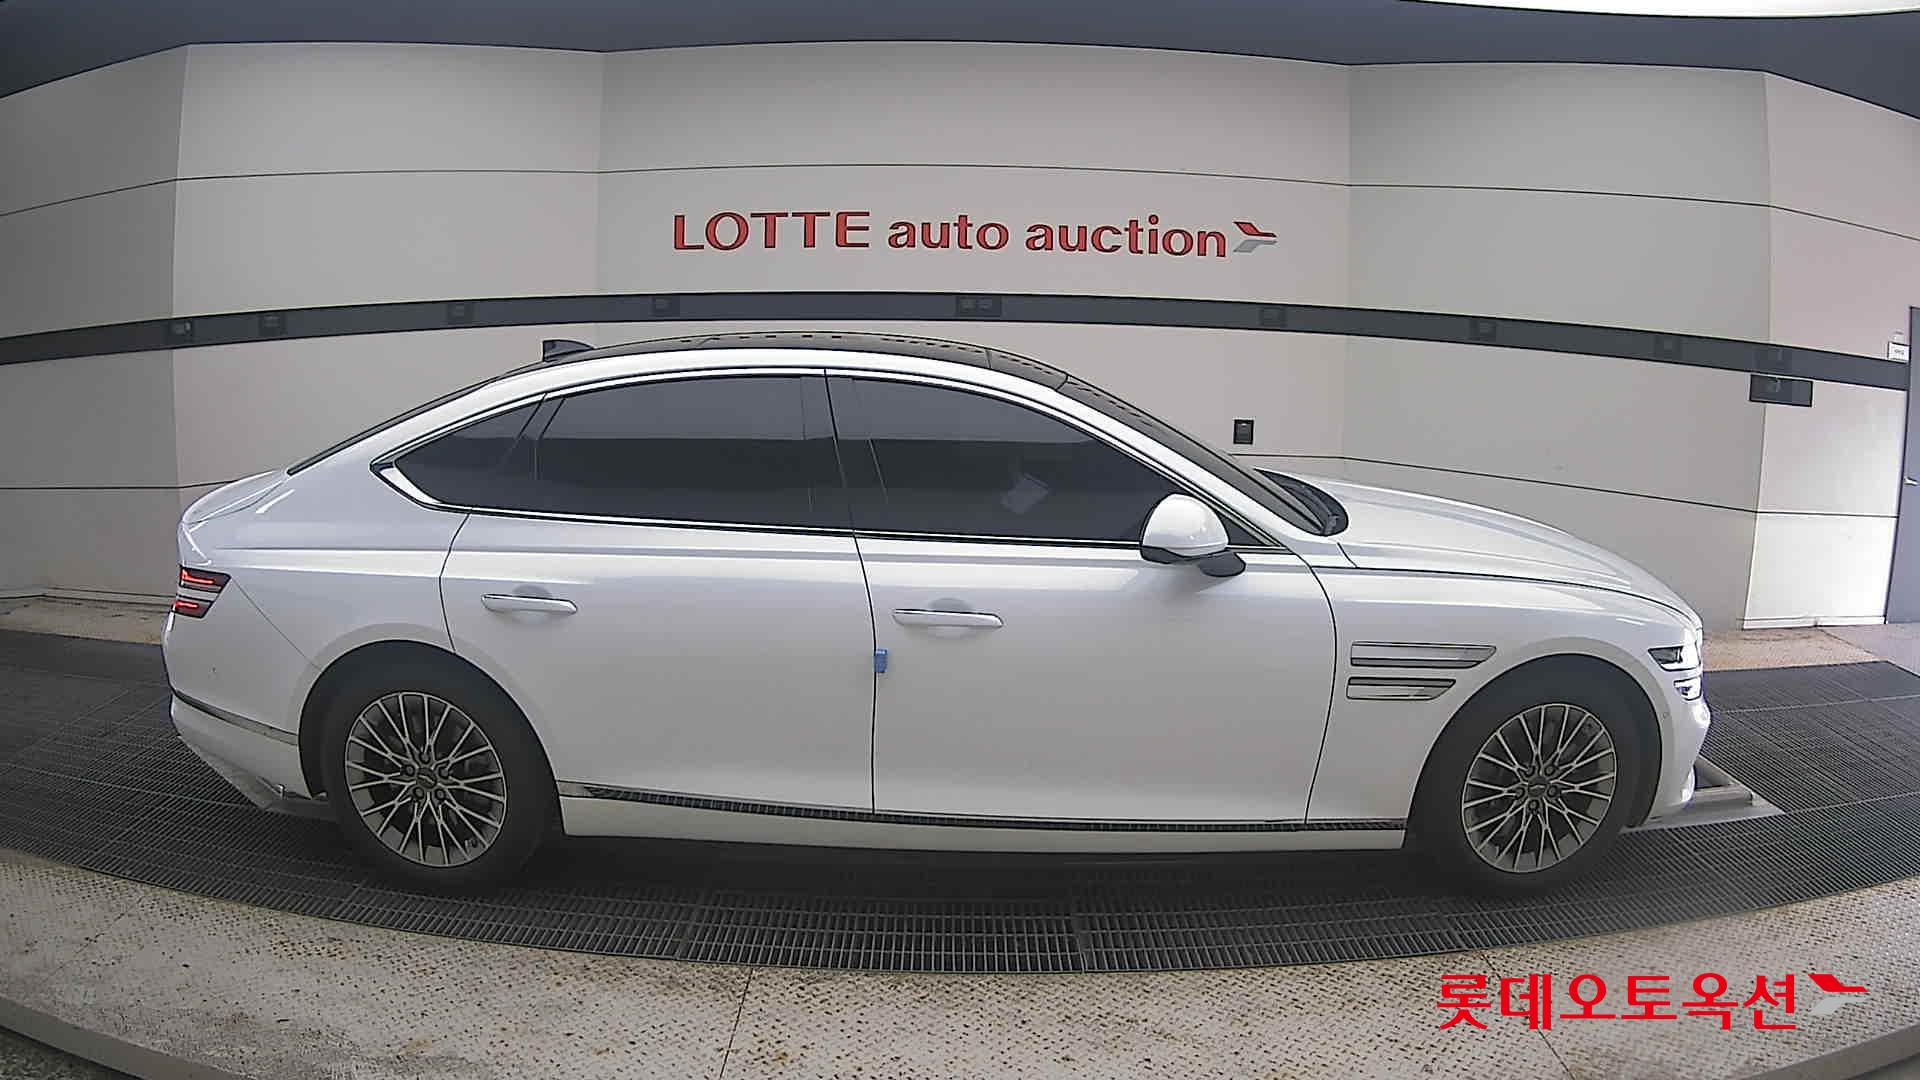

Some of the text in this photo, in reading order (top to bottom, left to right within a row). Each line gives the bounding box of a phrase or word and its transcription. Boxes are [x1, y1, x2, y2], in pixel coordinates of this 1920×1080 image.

[673, 211, 1227, 258] LOTTE auto auction
